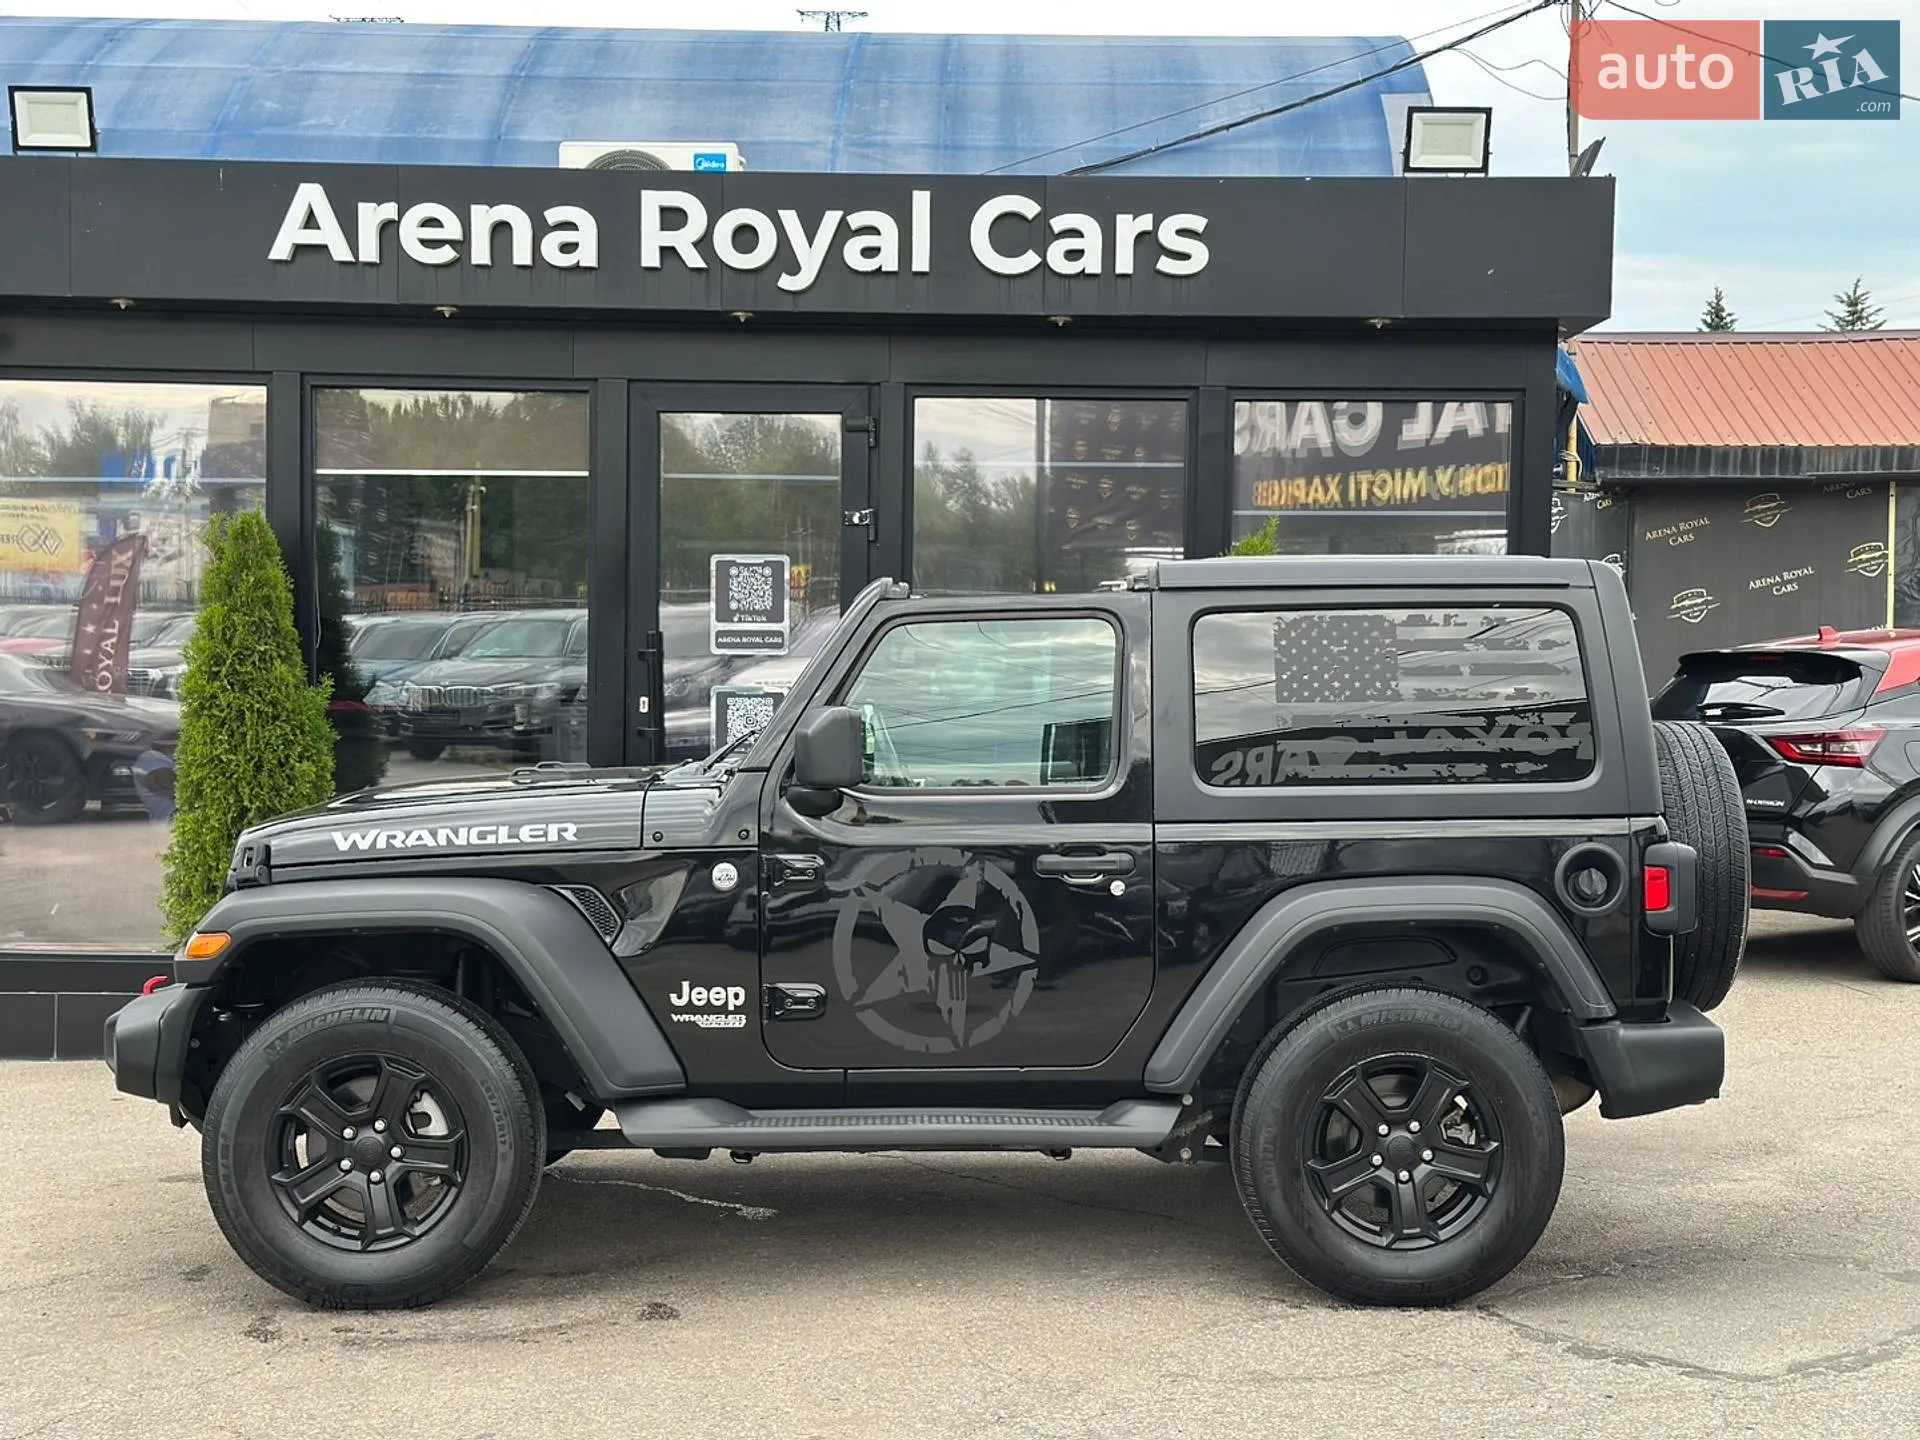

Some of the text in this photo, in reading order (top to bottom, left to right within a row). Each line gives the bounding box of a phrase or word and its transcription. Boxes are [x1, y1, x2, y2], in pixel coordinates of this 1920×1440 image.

[268, 182, 1210, 291] Arena Royal Cars
[1645, 517, 1711, 541] ARENA ROYAL
[1669, 533, 1695, 547] CARS
[1749, 566, 1815, 591] ARENA ROYAL
[1773, 582, 1799, 596] CARS
[96, 619, 119, 694] OYAL
[331, 822, 578, 851] WRANGLER
[669, 980, 746, 1011] Jeep
[287, 1008, 390, 1043] MICHELIN
[671, 1013, 746, 1023] WRANGLER
